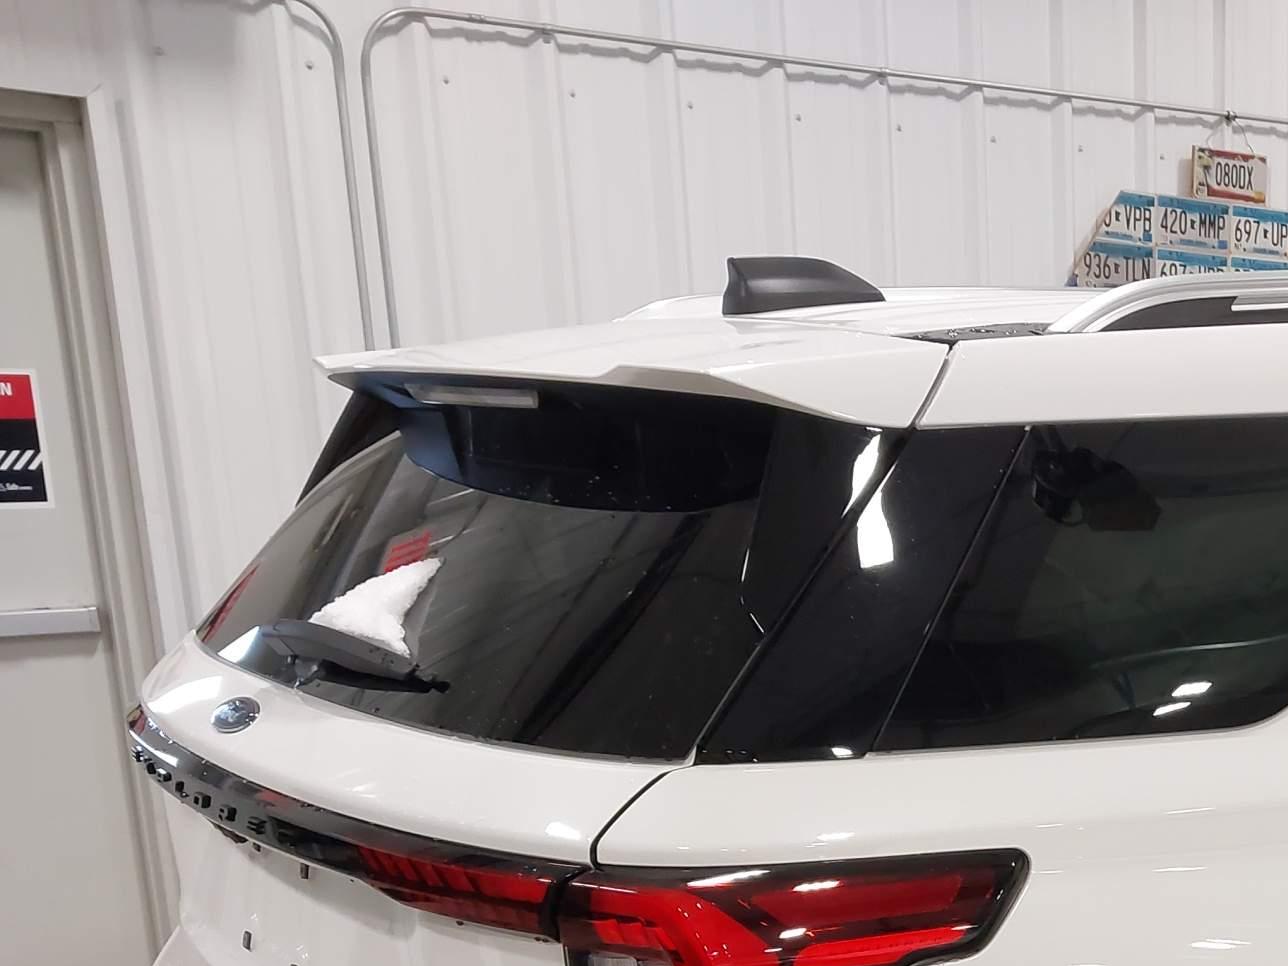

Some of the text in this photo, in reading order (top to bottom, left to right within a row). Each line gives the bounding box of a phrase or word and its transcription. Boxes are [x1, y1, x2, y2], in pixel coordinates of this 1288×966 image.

[1160, 207, 1226, 240] 420 MMP
[1234, 218, 1260, 245] 697
[1083, 252, 1111, 279] 936
